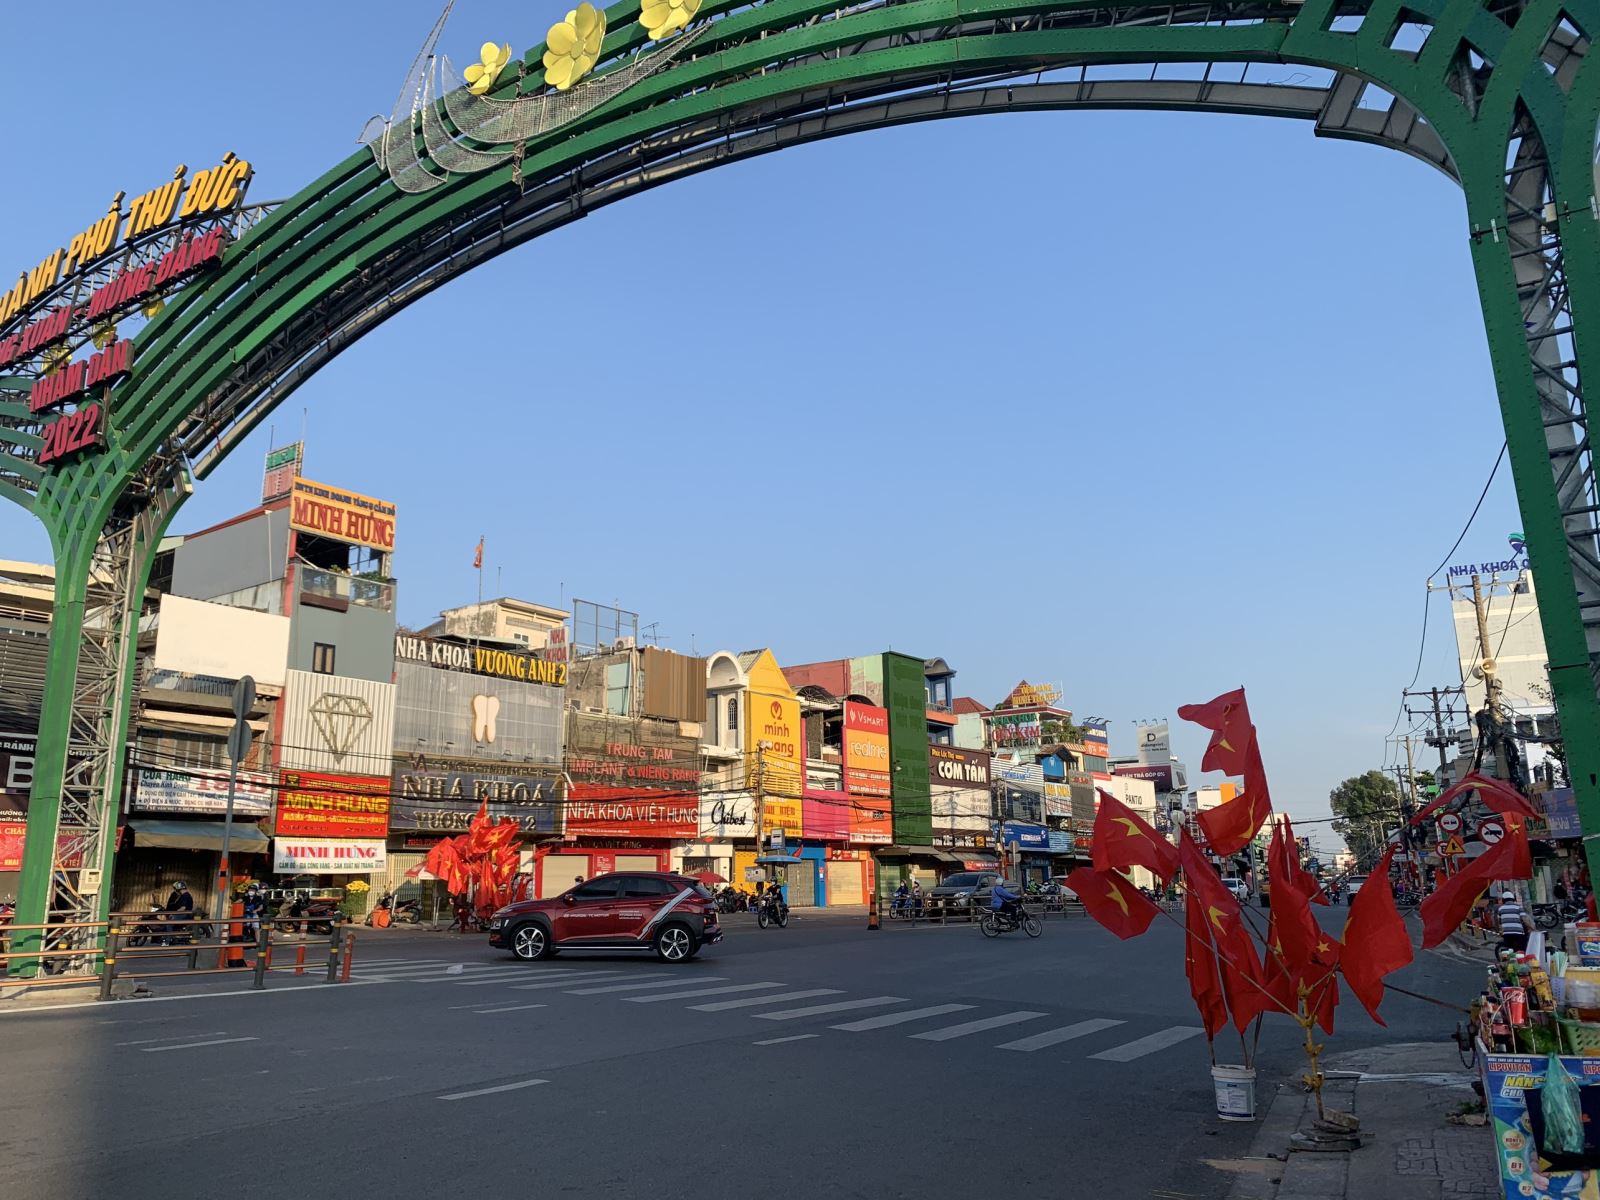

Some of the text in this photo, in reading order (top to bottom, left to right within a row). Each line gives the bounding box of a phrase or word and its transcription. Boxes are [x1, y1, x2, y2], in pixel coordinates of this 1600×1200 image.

[63, 191, 123, 278] PHỐ
[124, 165, 186, 241] THỦ
[180, 152, 250, 218] ĐỨC
[39, 404, 100, 464] 2022
[293, 496, 394, 548] MINH HƯNG
[1450, 564, 1478, 577] NHA
[1482, 560, 1519, 574] KHOA
[396, 636, 567, 686] NHA KHOA VƯƠNG ANH 2
[764, 722, 790, 738] minh
[607, 742, 646, 759] TRUNG
[850, 739, 887, 760] realme
[938, 759, 986, 783] CƠM TẤM
[401, 774, 464, 799] NHA
[473, 778, 545, 807] KHOA
[568, 802, 698, 825] NHA KHOA VIỆT HƯNG
[286, 846, 328, 858] MINH
[1488, 1062, 1533, 1073] LIPOVITAN
